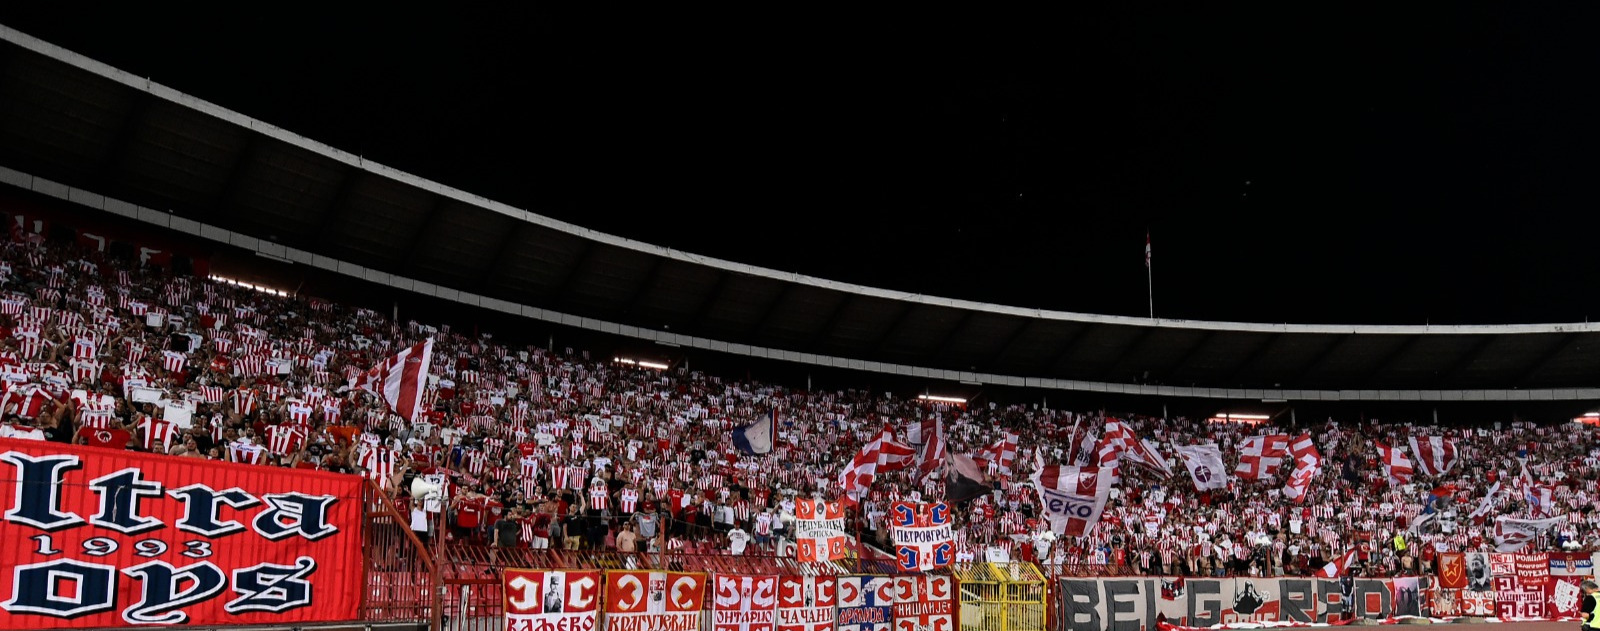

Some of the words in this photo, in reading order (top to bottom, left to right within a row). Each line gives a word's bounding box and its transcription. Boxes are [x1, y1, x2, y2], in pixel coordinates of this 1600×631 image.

[1043, 497, 1093, 518] eko
[896, 526, 952, 543] ПЕТРОВГРАД
[29, 534, 214, 558] 1993
[0, 555, 317, 624] oys
[716, 608, 773, 624] ОНТАРИО
[780, 607, 834, 624] ЧАЧАНИ
[839, 606, 885, 625] АРМИЈА
